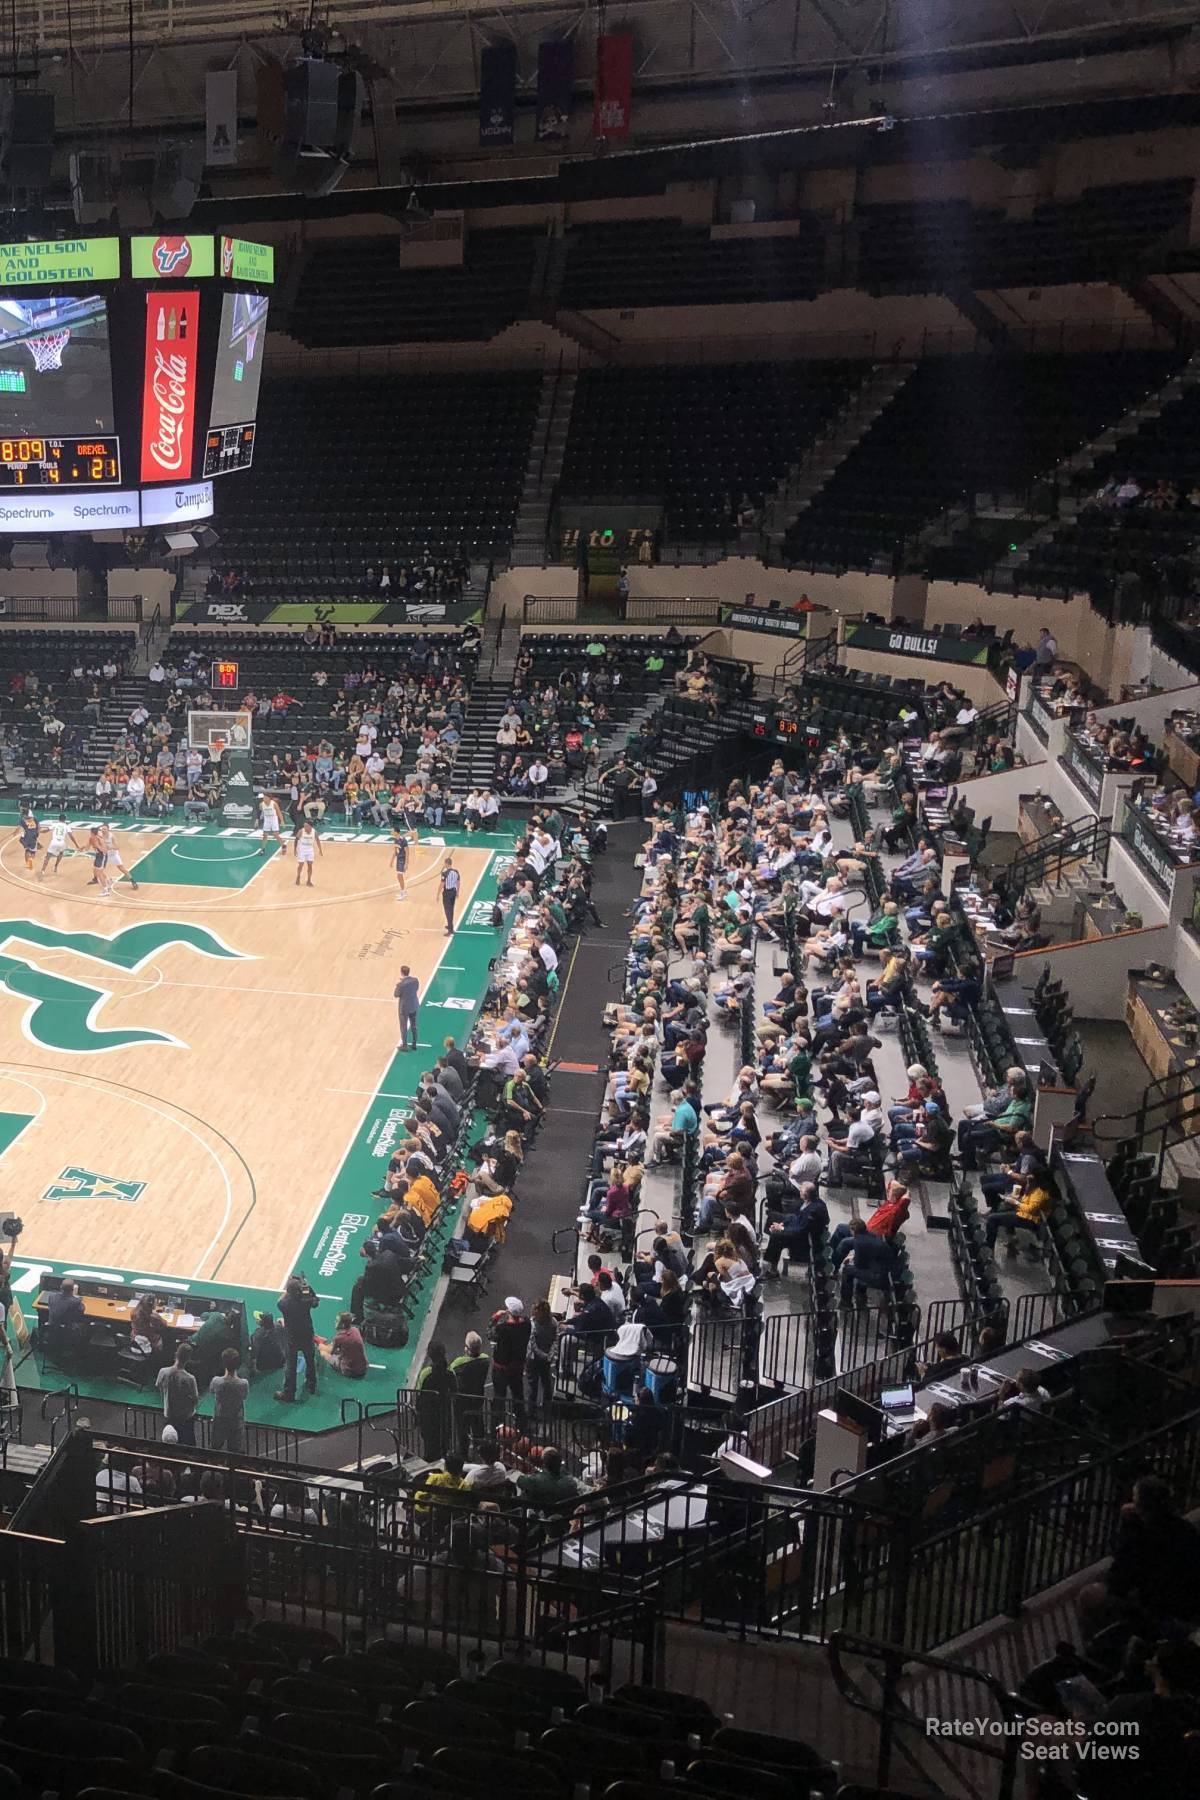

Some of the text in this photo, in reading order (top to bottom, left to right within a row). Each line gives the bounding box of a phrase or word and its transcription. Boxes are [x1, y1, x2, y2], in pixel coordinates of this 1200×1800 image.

[24, 241, 88, 256] NELSON
[5, 257, 40, 270] AND
[5, 267, 94, 283] GOLDSTEIN
[150, 346, 188, 470] Coca-Cola
[2, 441, 43, 462] 8:09
[52, 449, 60, 459] 4
[77, 444, 107, 455] DREXEL
[91, 459, 116, 479] 21
[48, 470, 59, 484] 4
[0, 508, 51, 521] Spectrum
[73, 504, 127, 518] Spectrum
[207, 604, 245, 616] DEX
[889, 633, 938, 655] GO BULLS!
[319, 1224, 358, 1277] CenterState
